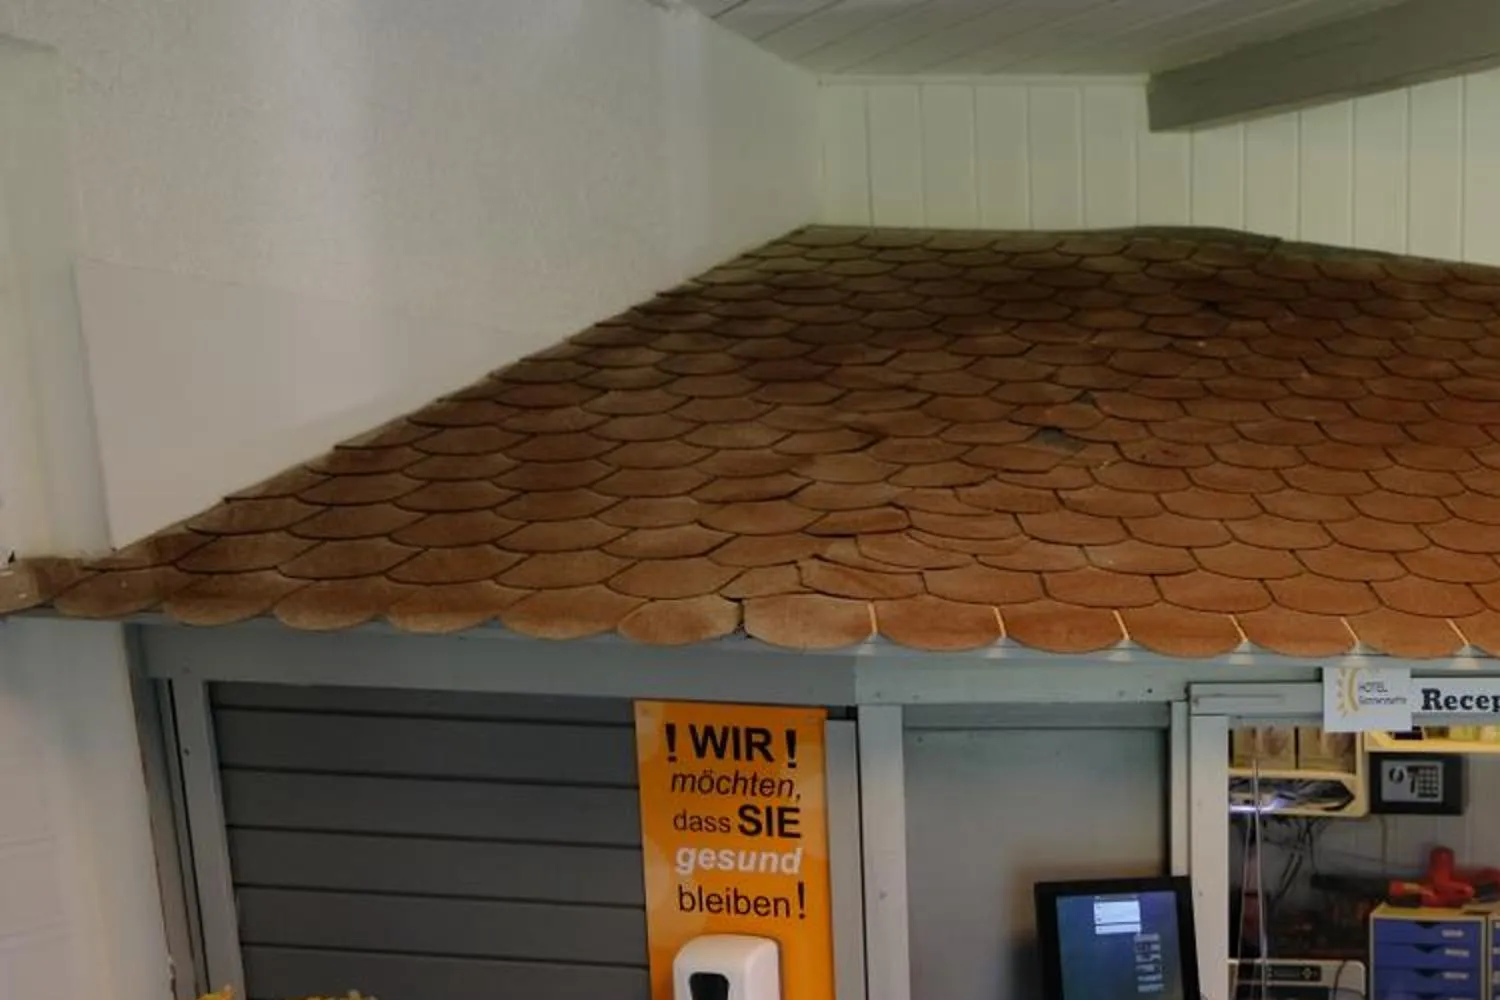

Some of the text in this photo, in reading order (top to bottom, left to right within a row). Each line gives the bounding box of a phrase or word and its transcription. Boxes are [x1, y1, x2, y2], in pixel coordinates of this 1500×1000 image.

[670, 769, 802, 801] möchten,
[673, 804, 803, 839] dass SIE
[675, 846, 803, 875] gesund
